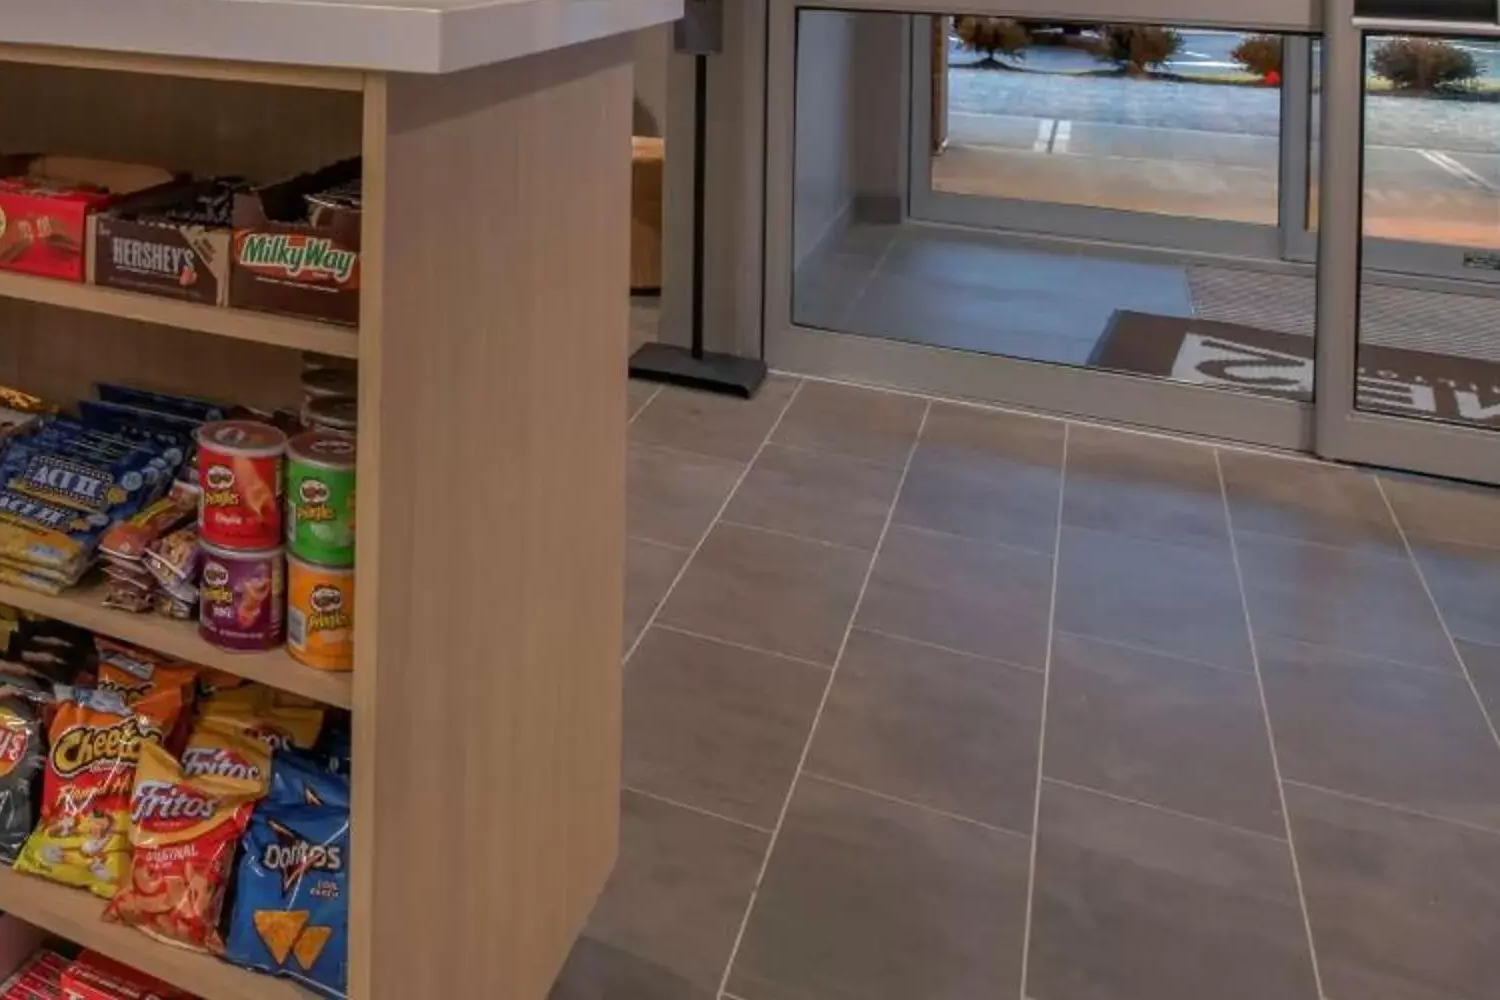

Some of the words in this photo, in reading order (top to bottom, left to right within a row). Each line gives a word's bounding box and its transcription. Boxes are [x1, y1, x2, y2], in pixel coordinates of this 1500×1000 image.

[113, 236, 197, 274] HERSHEY'S
[131, 780, 220, 822] Fritos
[263, 842, 342, 871] Doritos
